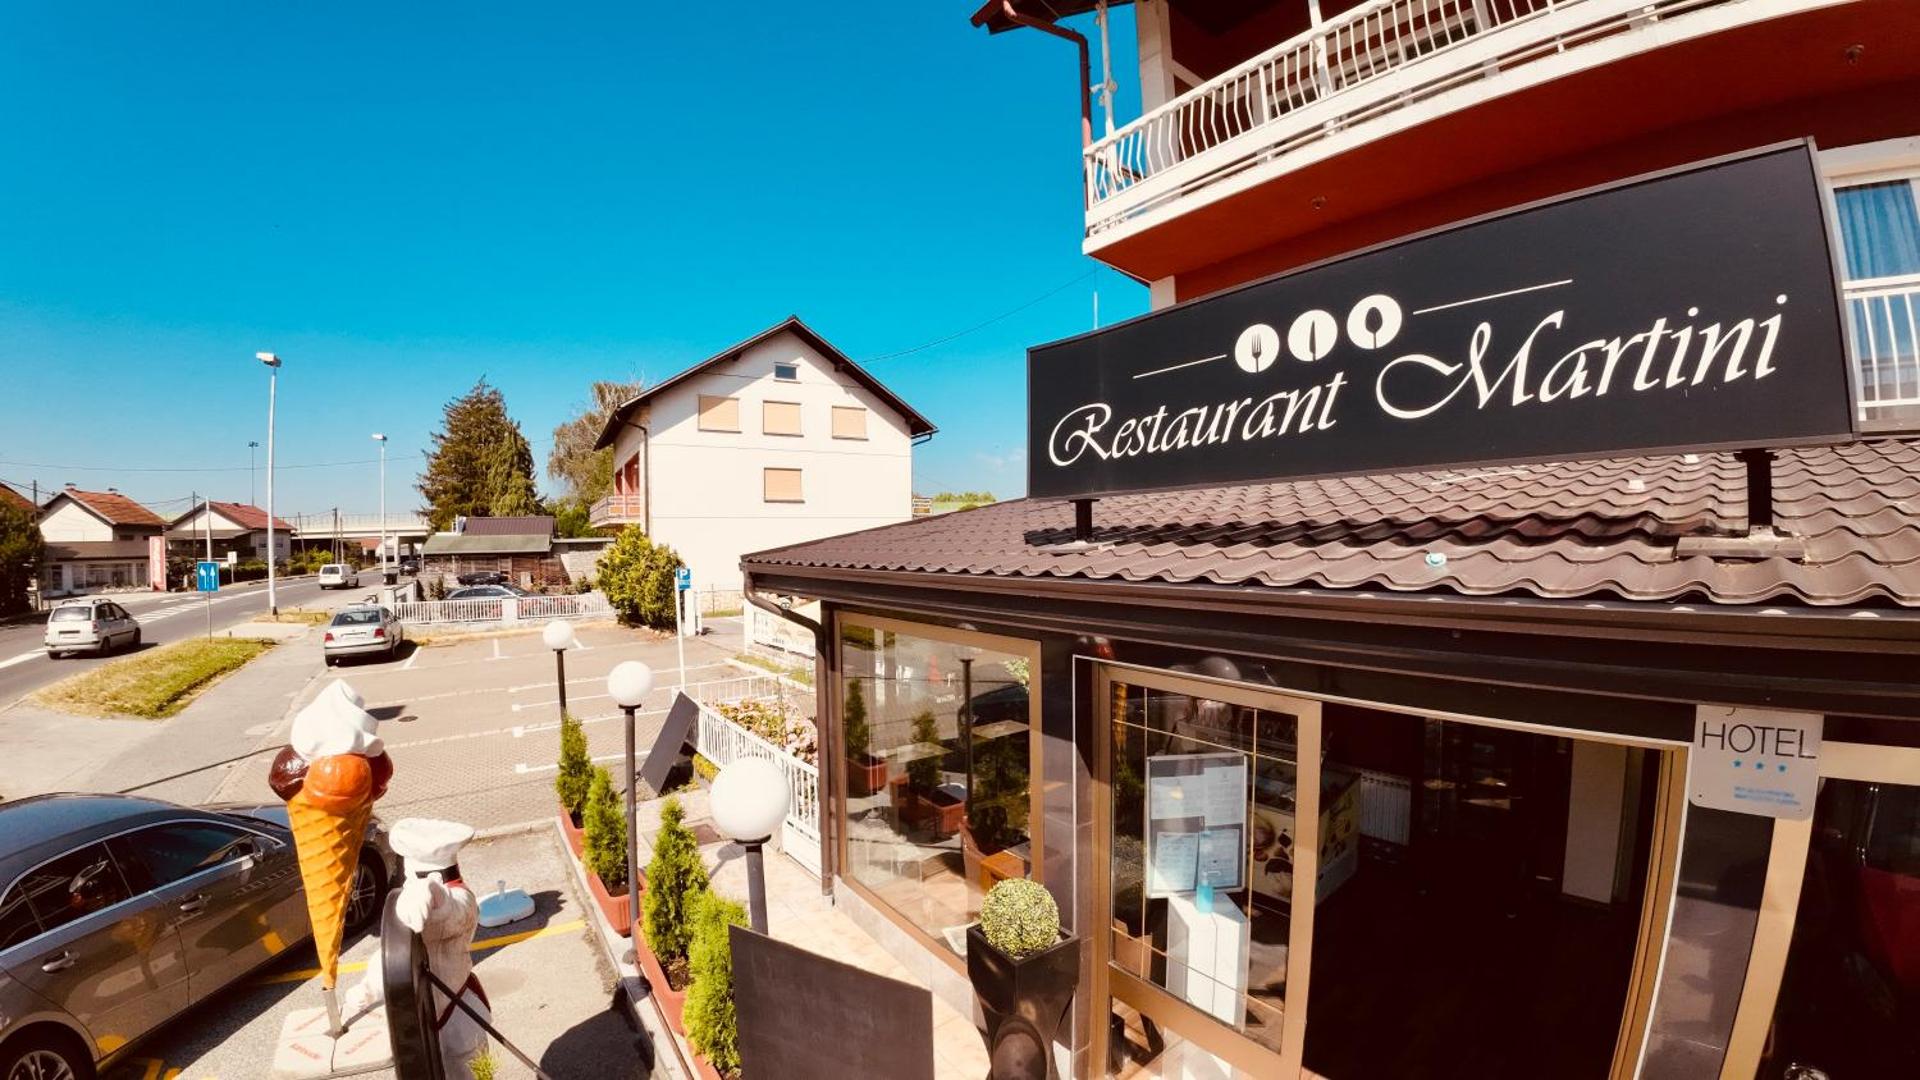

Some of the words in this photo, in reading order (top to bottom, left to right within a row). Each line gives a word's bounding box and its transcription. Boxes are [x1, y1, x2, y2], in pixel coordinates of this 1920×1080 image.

[1048, 371, 1347, 467] Restaurant
[1375, 294, 1788, 419] Martini
[1702, 721, 1818, 760] HOTEL
